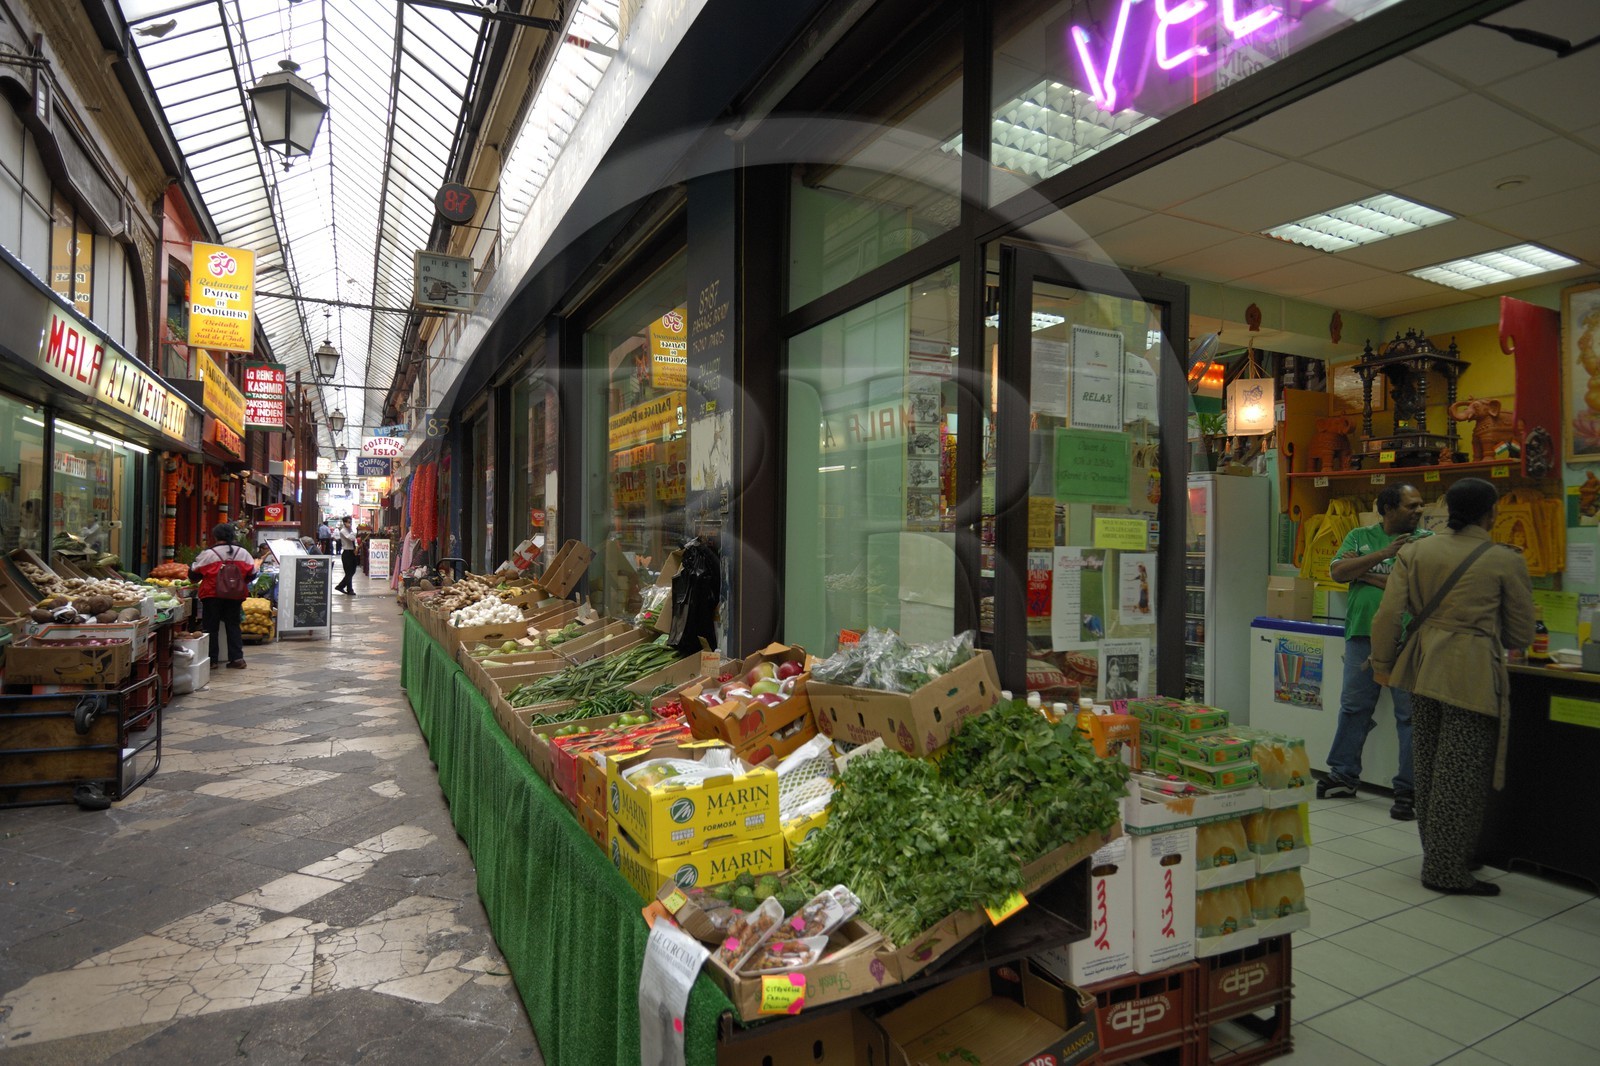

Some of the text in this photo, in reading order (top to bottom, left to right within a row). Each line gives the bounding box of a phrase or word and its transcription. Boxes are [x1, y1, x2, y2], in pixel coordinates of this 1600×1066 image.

[444, 190, 470, 213] 87
[197, 278, 249, 291] Restaurant
[193, 305, 248, 319] PONDICHERY
[46, 314, 105, 389] MALA
[246, 368, 284, 381] La REINE du
[248, 381, 283, 394] KASHMIR
[1082, 391, 1113, 404] RELAX
[245, 399, 283, 410] PAKISTANAIS
[256, 409, 284, 417] INDIEN
[363, 437, 405, 453] COIFFURE
[373, 448, 398, 456] ISLO
[358, 458, 389, 468] COIFFURE
[371, 551, 389, 559] DOVE
[1028, 570, 1049, 581] PARIS
[707, 784, 770, 810] MARIN
[622, 789, 647, 831] MARIN
[707, 800, 770, 817] PAPAYA
[703, 819, 737, 832] FORMOSA
[711, 847, 773, 876] MARIN
[653, 930, 697, 970] LE CURCUMA
[1062, 1031, 1095, 1057] MANGO
